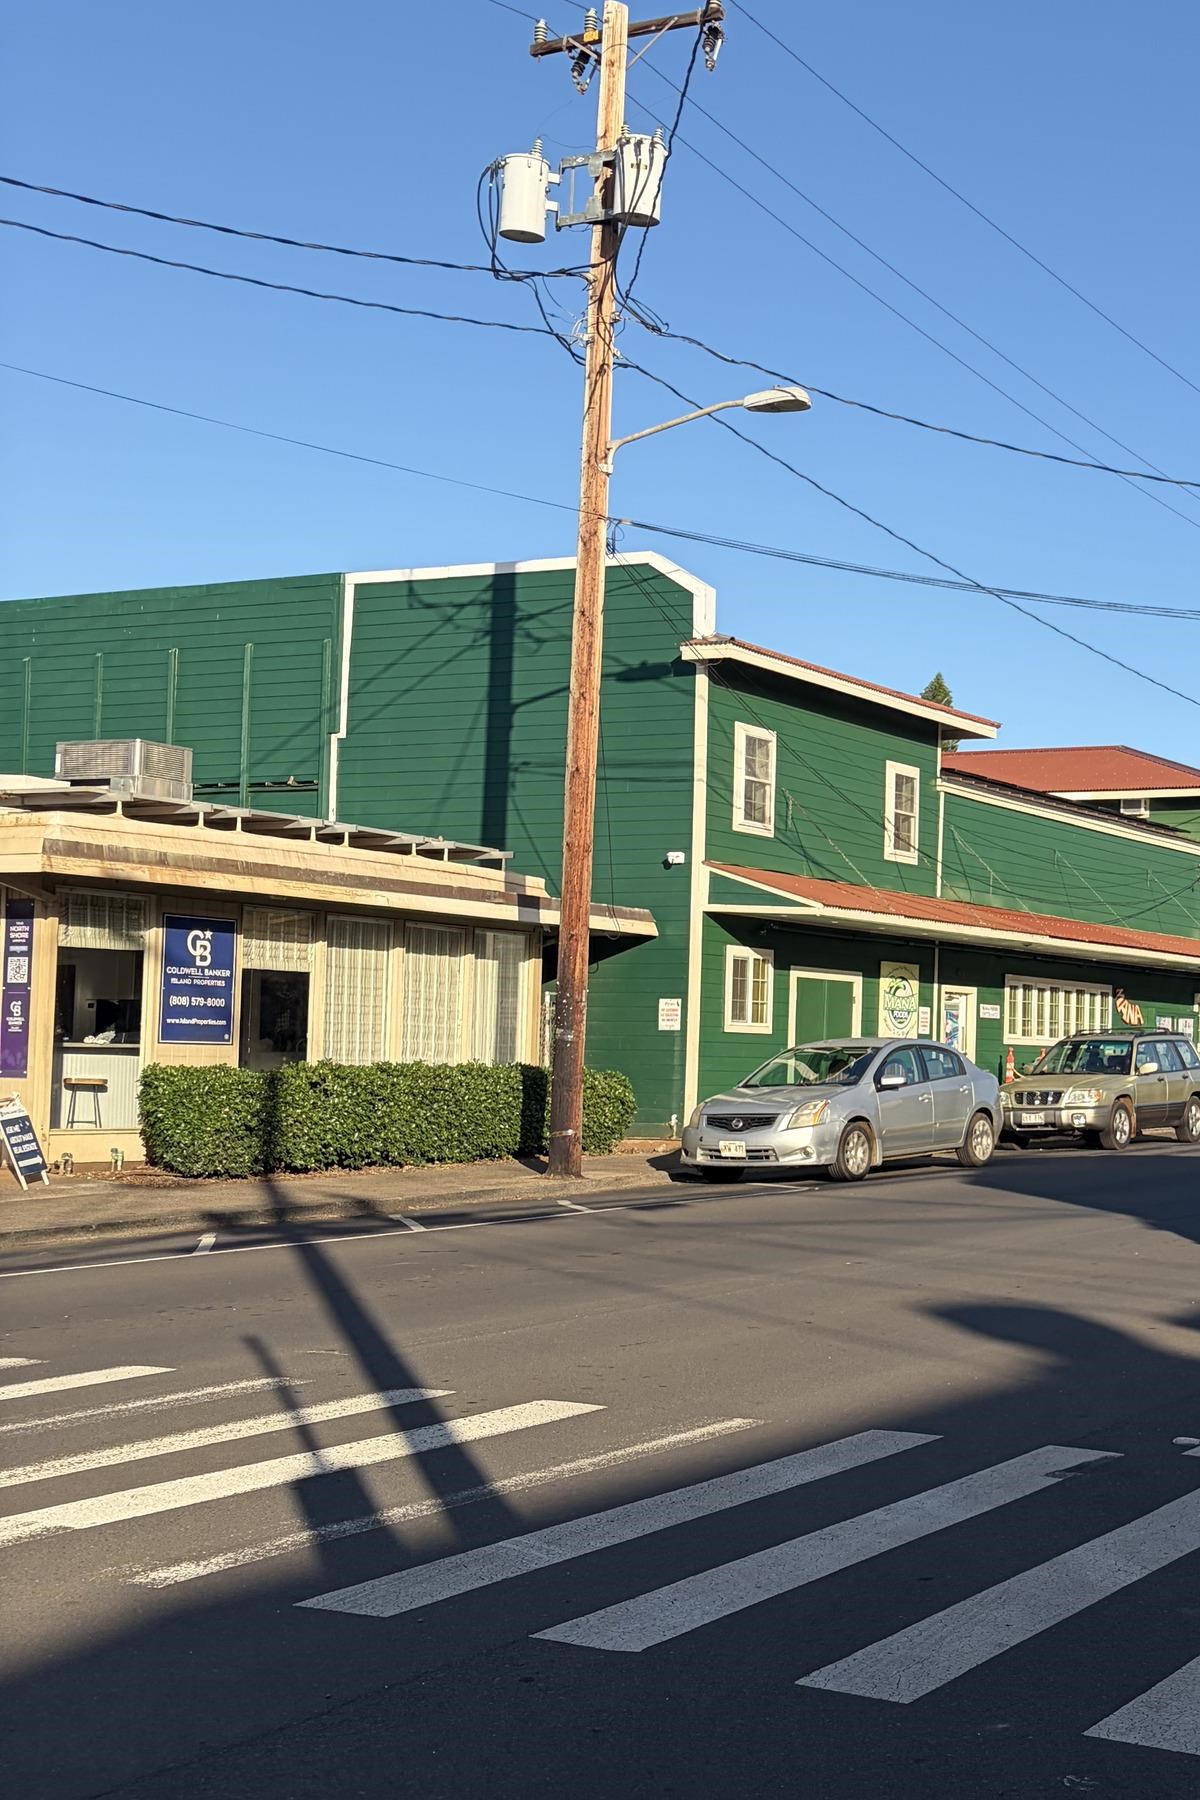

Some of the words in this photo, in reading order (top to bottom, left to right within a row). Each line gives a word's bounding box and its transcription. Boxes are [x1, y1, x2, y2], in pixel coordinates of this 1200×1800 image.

[166, 966, 204, 976] COLDWELL
[204, 968, 231, 978] BANKER
[193, 978, 226, 987] PROPERTIES
[169, 995, 190, 1008] (808)
[885, 994, 916, 1009] MANA
